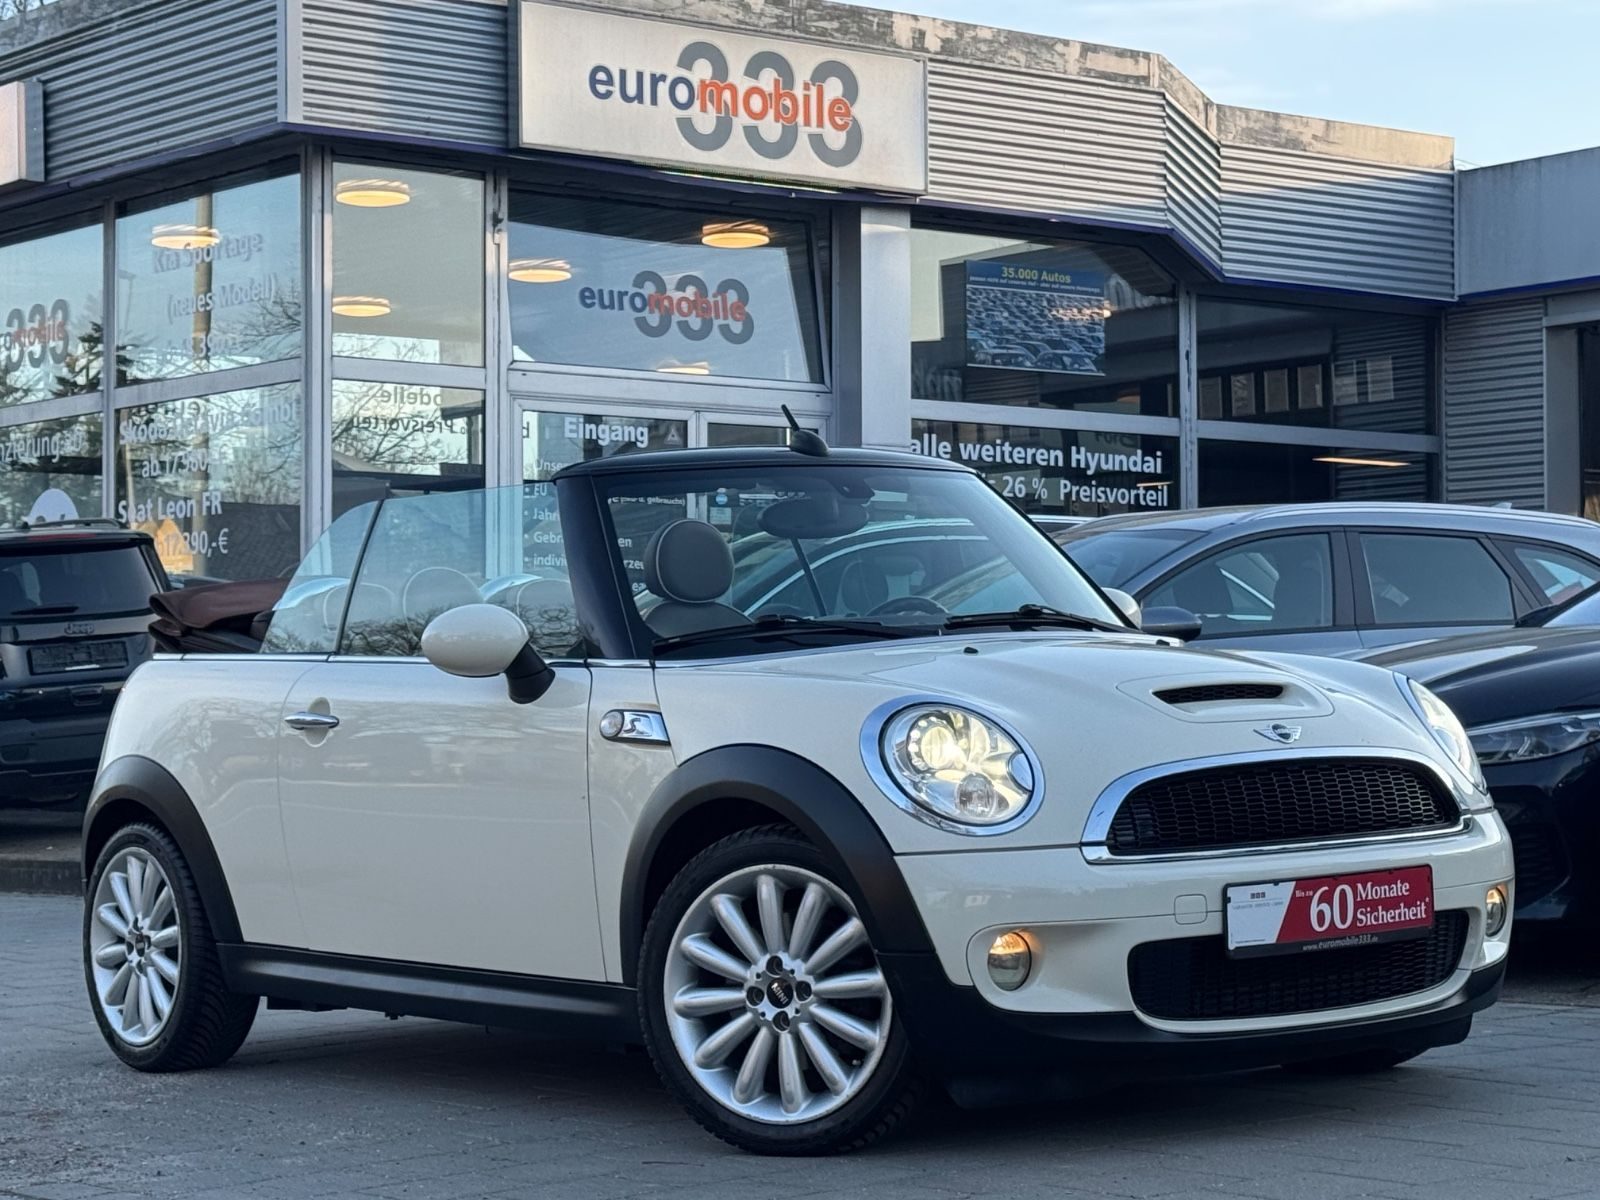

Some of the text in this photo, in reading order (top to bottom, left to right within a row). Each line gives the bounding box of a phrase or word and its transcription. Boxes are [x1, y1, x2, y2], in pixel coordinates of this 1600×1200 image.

[588, 64, 852, 132] euromobile
[1001, 266, 1072, 284] 35.000 Autos
[579, 284, 747, 322] euromobile
[563, 416, 649, 448] Eingang
[910, 433, 952, 458] alle
[959, 439, 1064, 468] weiteren
[1071, 446, 1163, 475] Hyundai
[118, 490, 223, 524] Seat Leon FR
[1002, 475, 1026, 499] 26
[1032, 478, 1048, 500] %
[1059, 480, 1168, 507] Preisvorteil
[63, 622, 95, 635] Jeep
[1356, 879, 1410, 901] Monate
[1310, 884, 1354, 933] 60
[770, 982, 789, 1005] MINI
